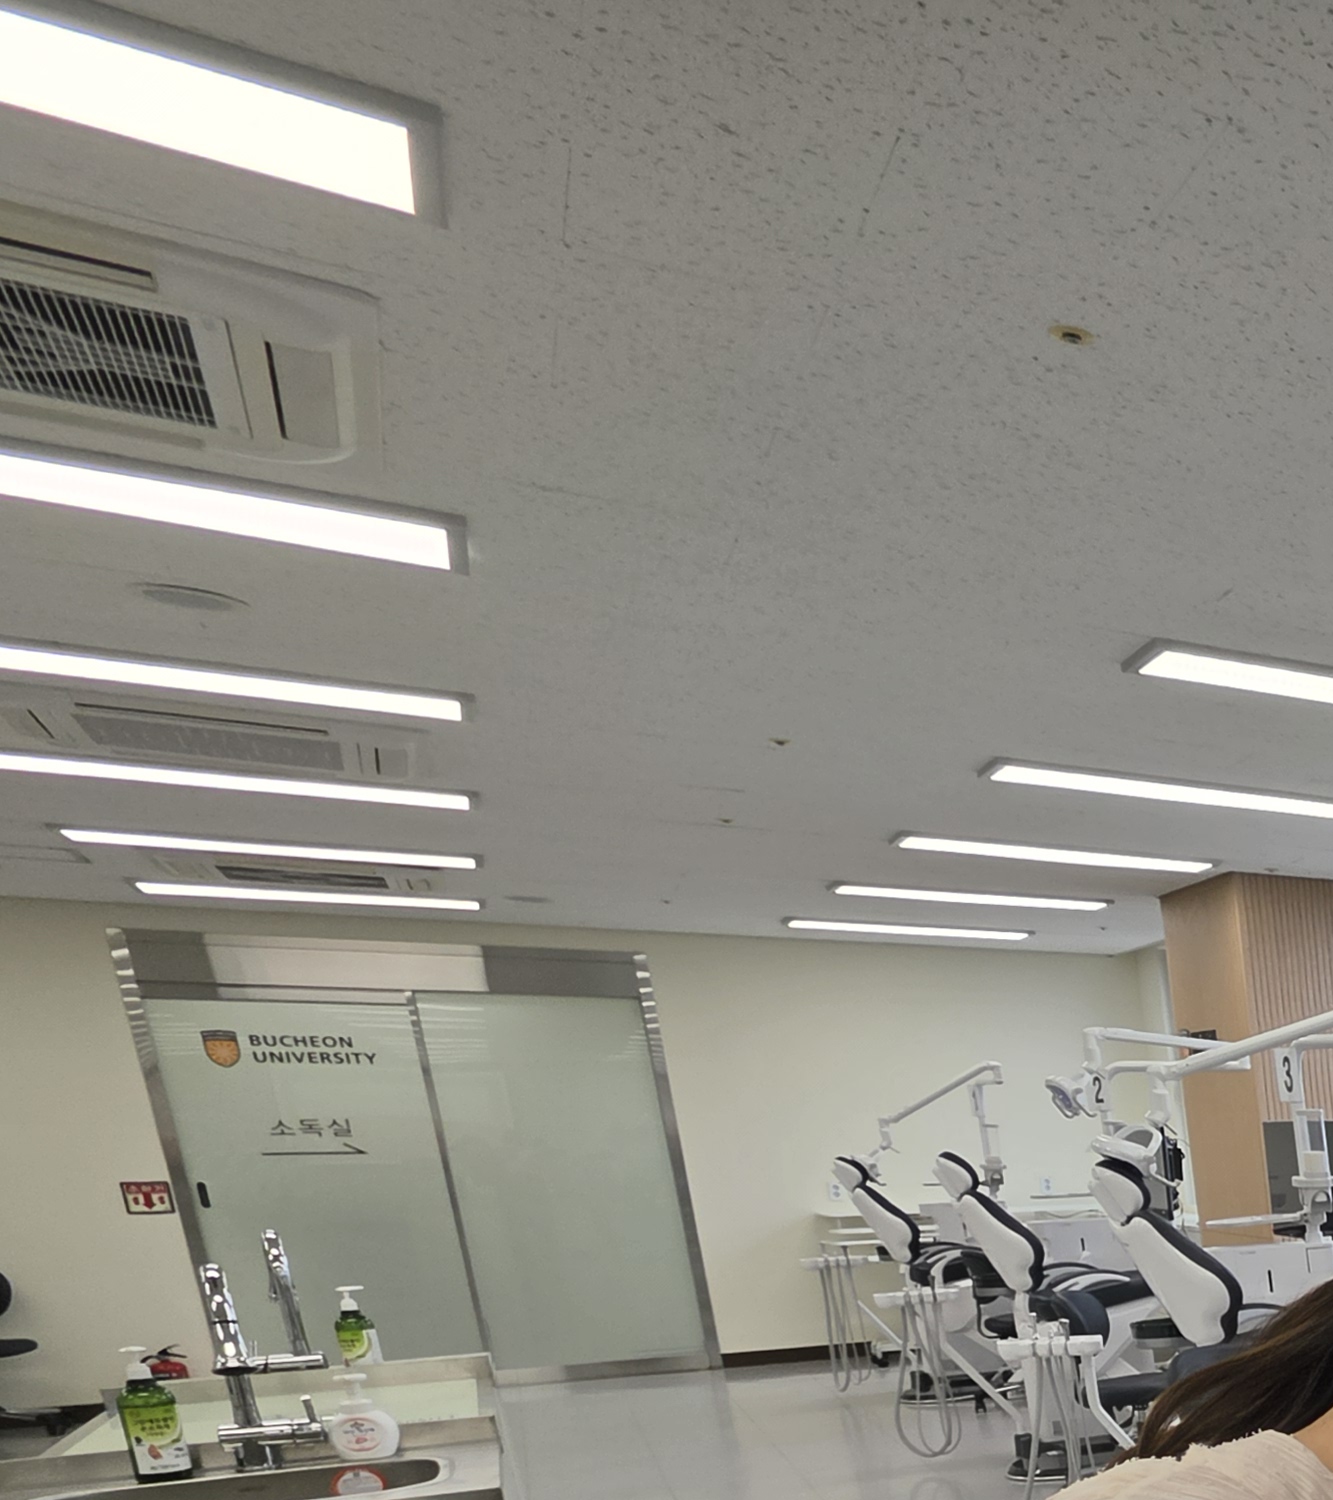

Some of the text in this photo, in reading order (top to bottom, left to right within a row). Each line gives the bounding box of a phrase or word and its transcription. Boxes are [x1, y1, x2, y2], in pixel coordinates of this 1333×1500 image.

[249, 1034, 353, 1048] BUCHEON
[252, 1051, 376, 1065] UNIVERSITY
[1282, 1056, 1293, 1093] 3
[1092, 1076, 1104, 1103] 2
[270, 1118, 353, 1137] 소독실
